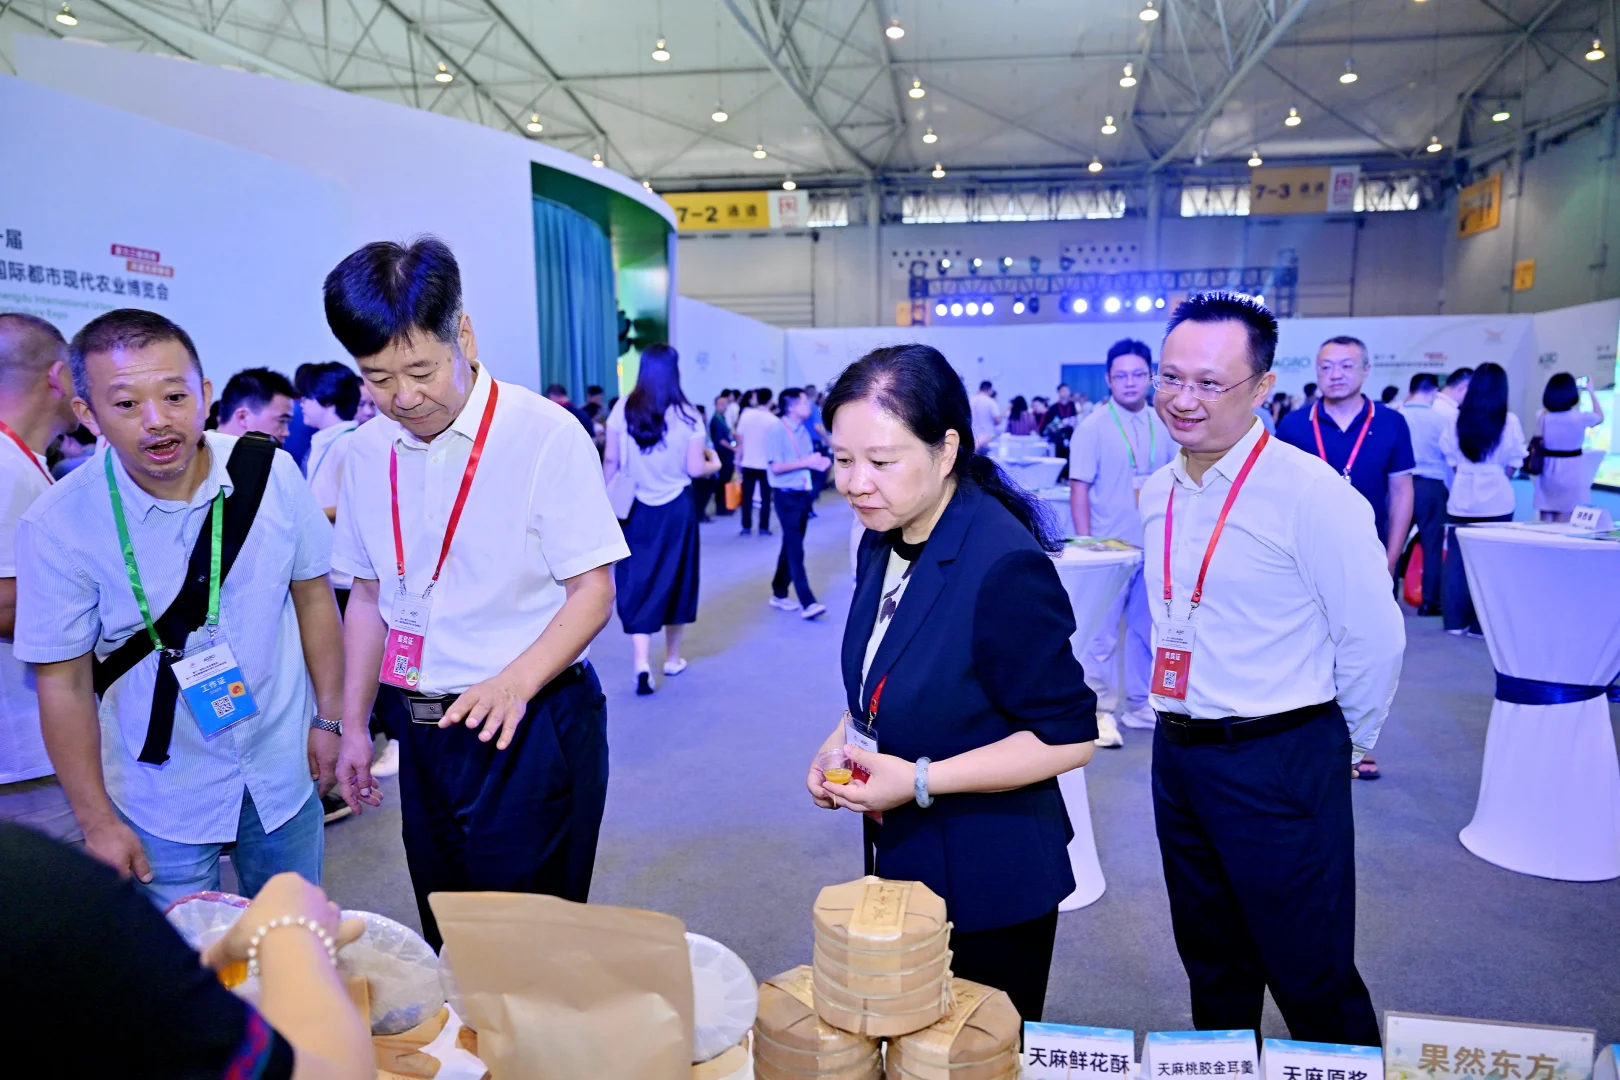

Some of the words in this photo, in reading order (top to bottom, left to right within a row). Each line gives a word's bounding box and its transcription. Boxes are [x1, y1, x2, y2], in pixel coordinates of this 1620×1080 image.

[676, 206, 718, 223] 7-2
[0, 228, 23, 250] 届
[200, 676, 226, 693] 工作证
[1029, 1047, 1130, 1074] 天麻鲜花酥
[1157, 1060, 1254, 1076] 天麻桃胶金耳羹
[1418, 1043, 1559, 1080] 果然东方
